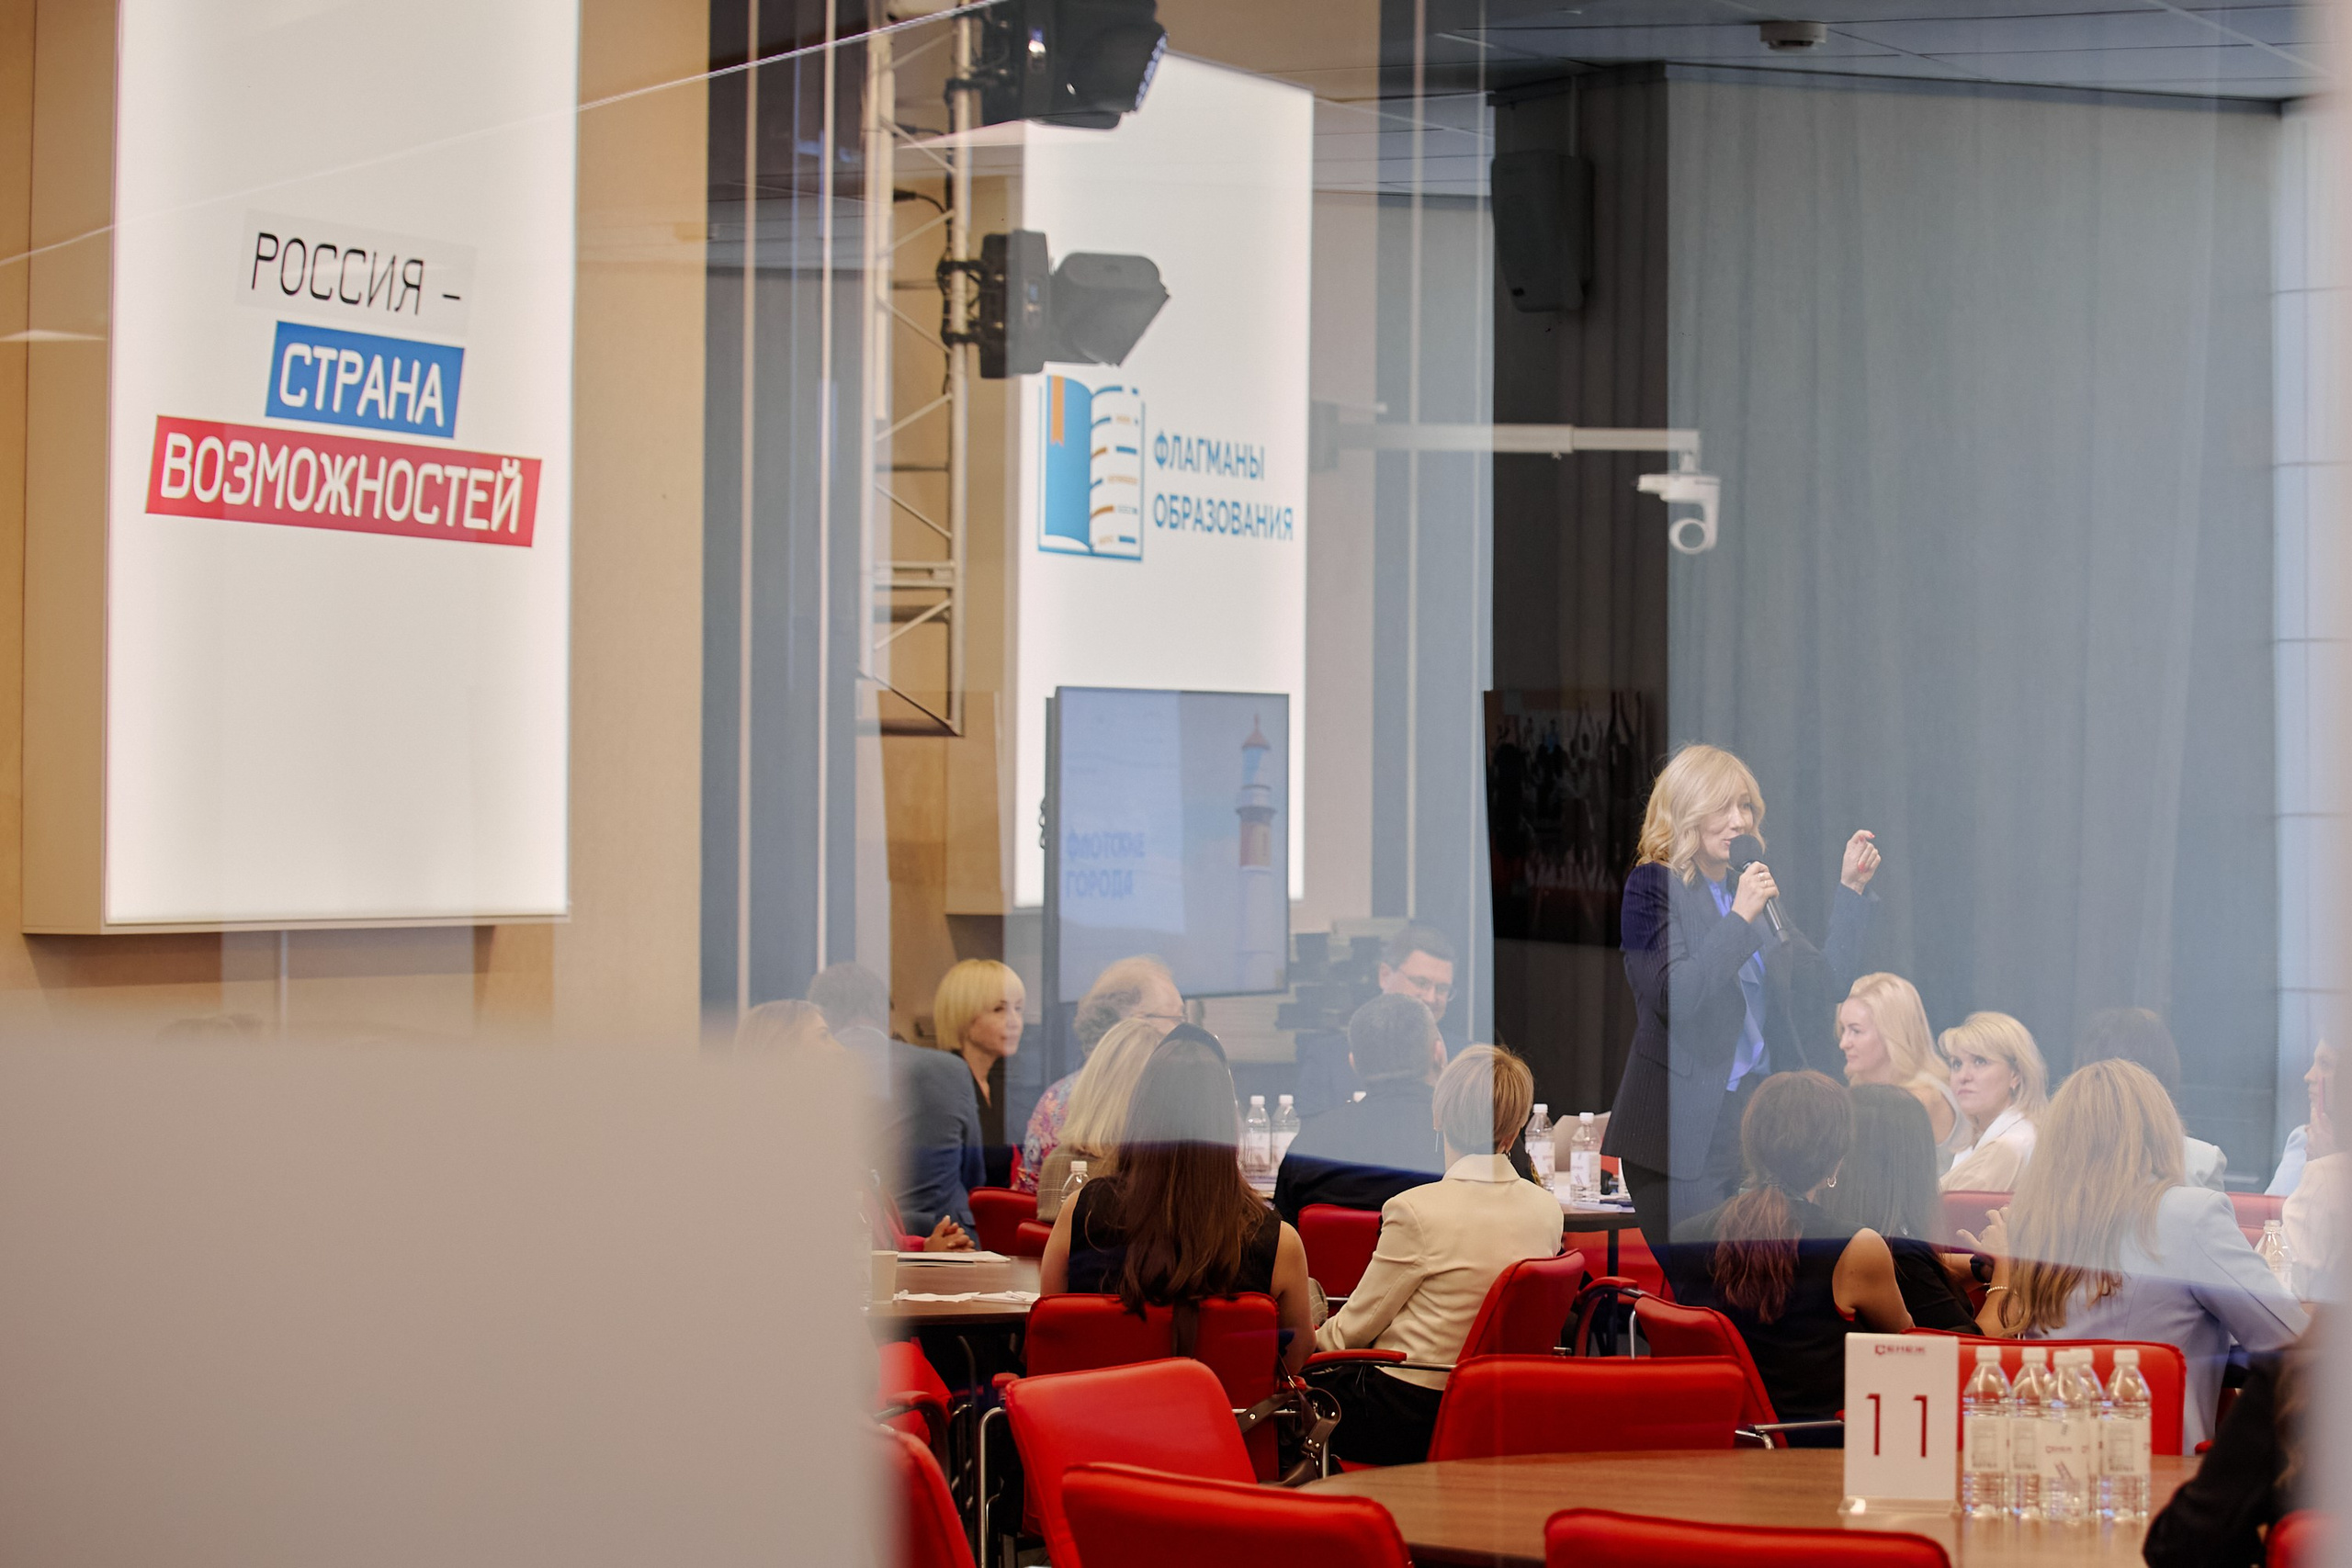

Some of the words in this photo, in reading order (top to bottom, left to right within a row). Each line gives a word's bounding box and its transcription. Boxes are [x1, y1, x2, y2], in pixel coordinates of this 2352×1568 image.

[251, 231, 424, 316] РОССИЯ
[278, 342, 445, 428] СТРАНА
[160, 431, 524, 535] ВОЗМОЖНОСТЕЙ
[1154, 428, 1264, 481] ФЛАГМАНЫ
[1153, 492, 1294, 541] ОБРАЗОВАНИЯ
[1865, 1393, 1928, 1459] 11
